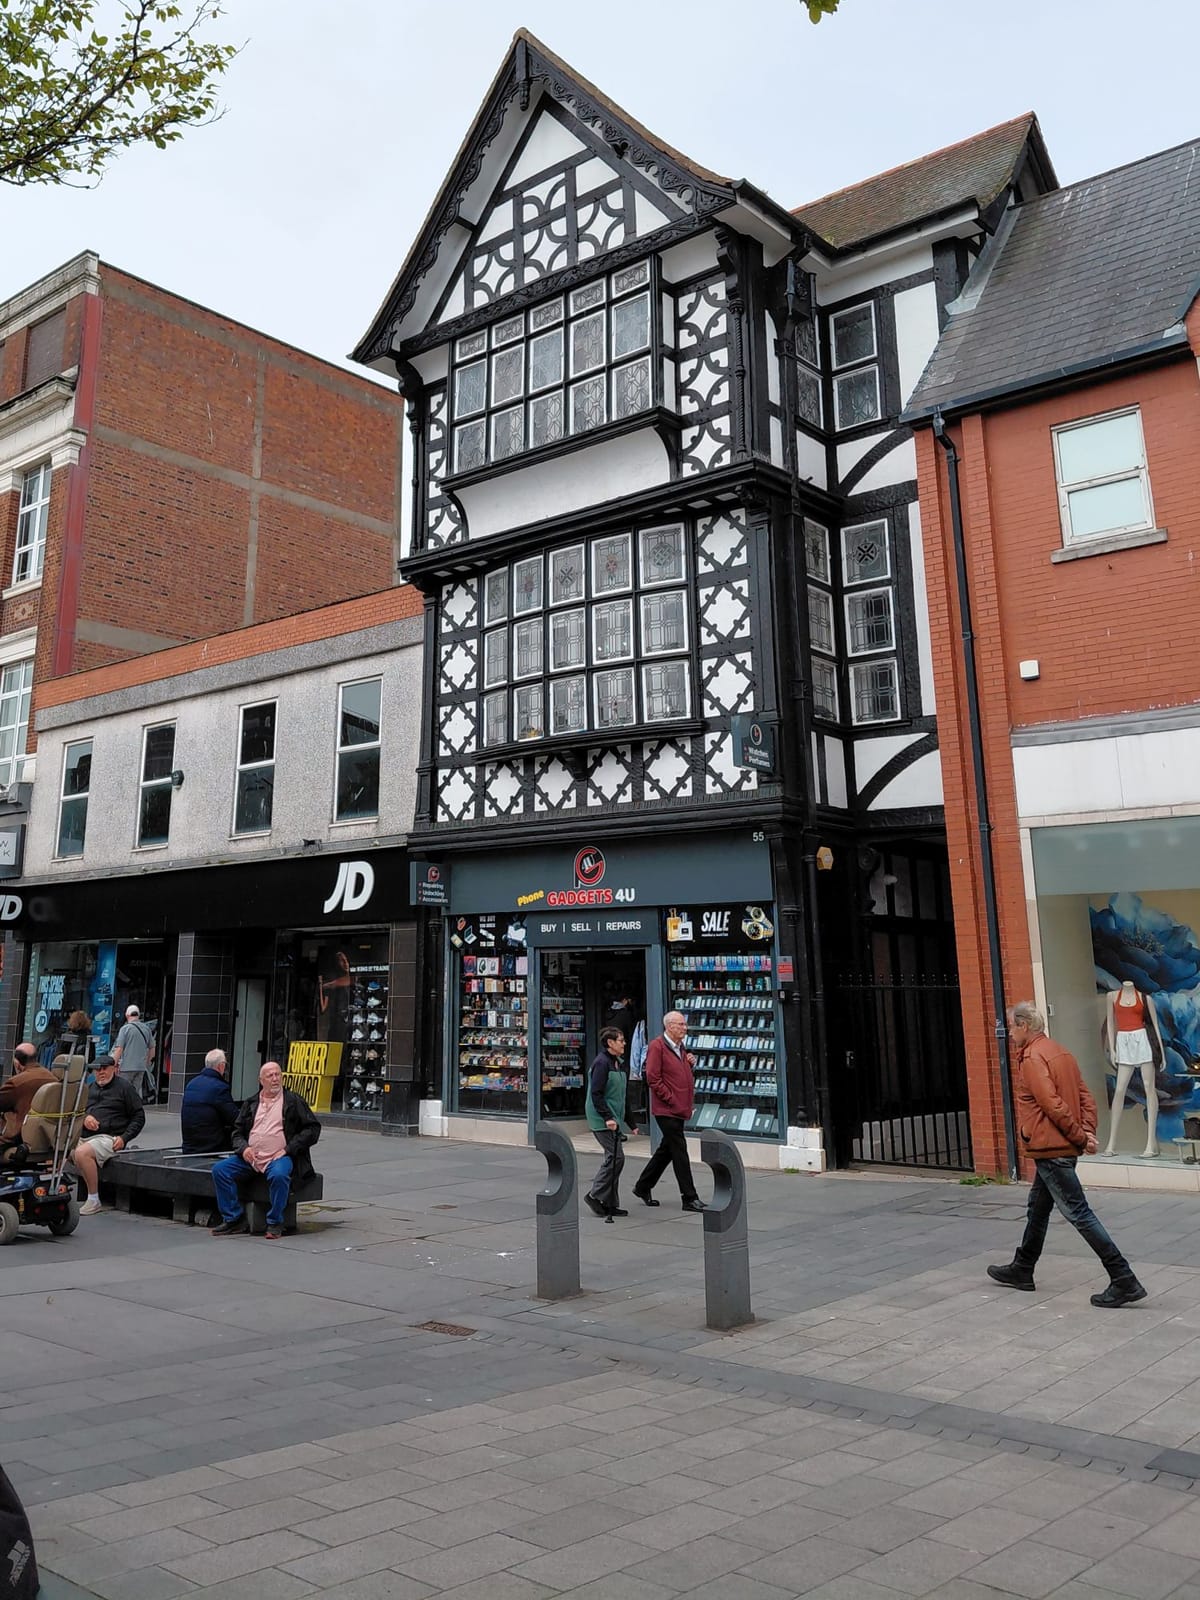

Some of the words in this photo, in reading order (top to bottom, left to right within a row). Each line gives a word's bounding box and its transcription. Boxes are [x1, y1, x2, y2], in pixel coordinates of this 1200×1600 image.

[753, 831, 764, 842] 55
[323, 861, 374, 914] JD
[517, 890, 545, 906] Phone
[547, 888, 613, 906] GADGETS
[615, 888, 635, 902] 4U
[541, 924, 557, 933] BUY
[571, 922, 592, 932] SELL
[606, 921, 642, 931] REPAIRS
[701, 911, 731, 932] SALE
[287, 1042, 328, 1075] FOREVER
